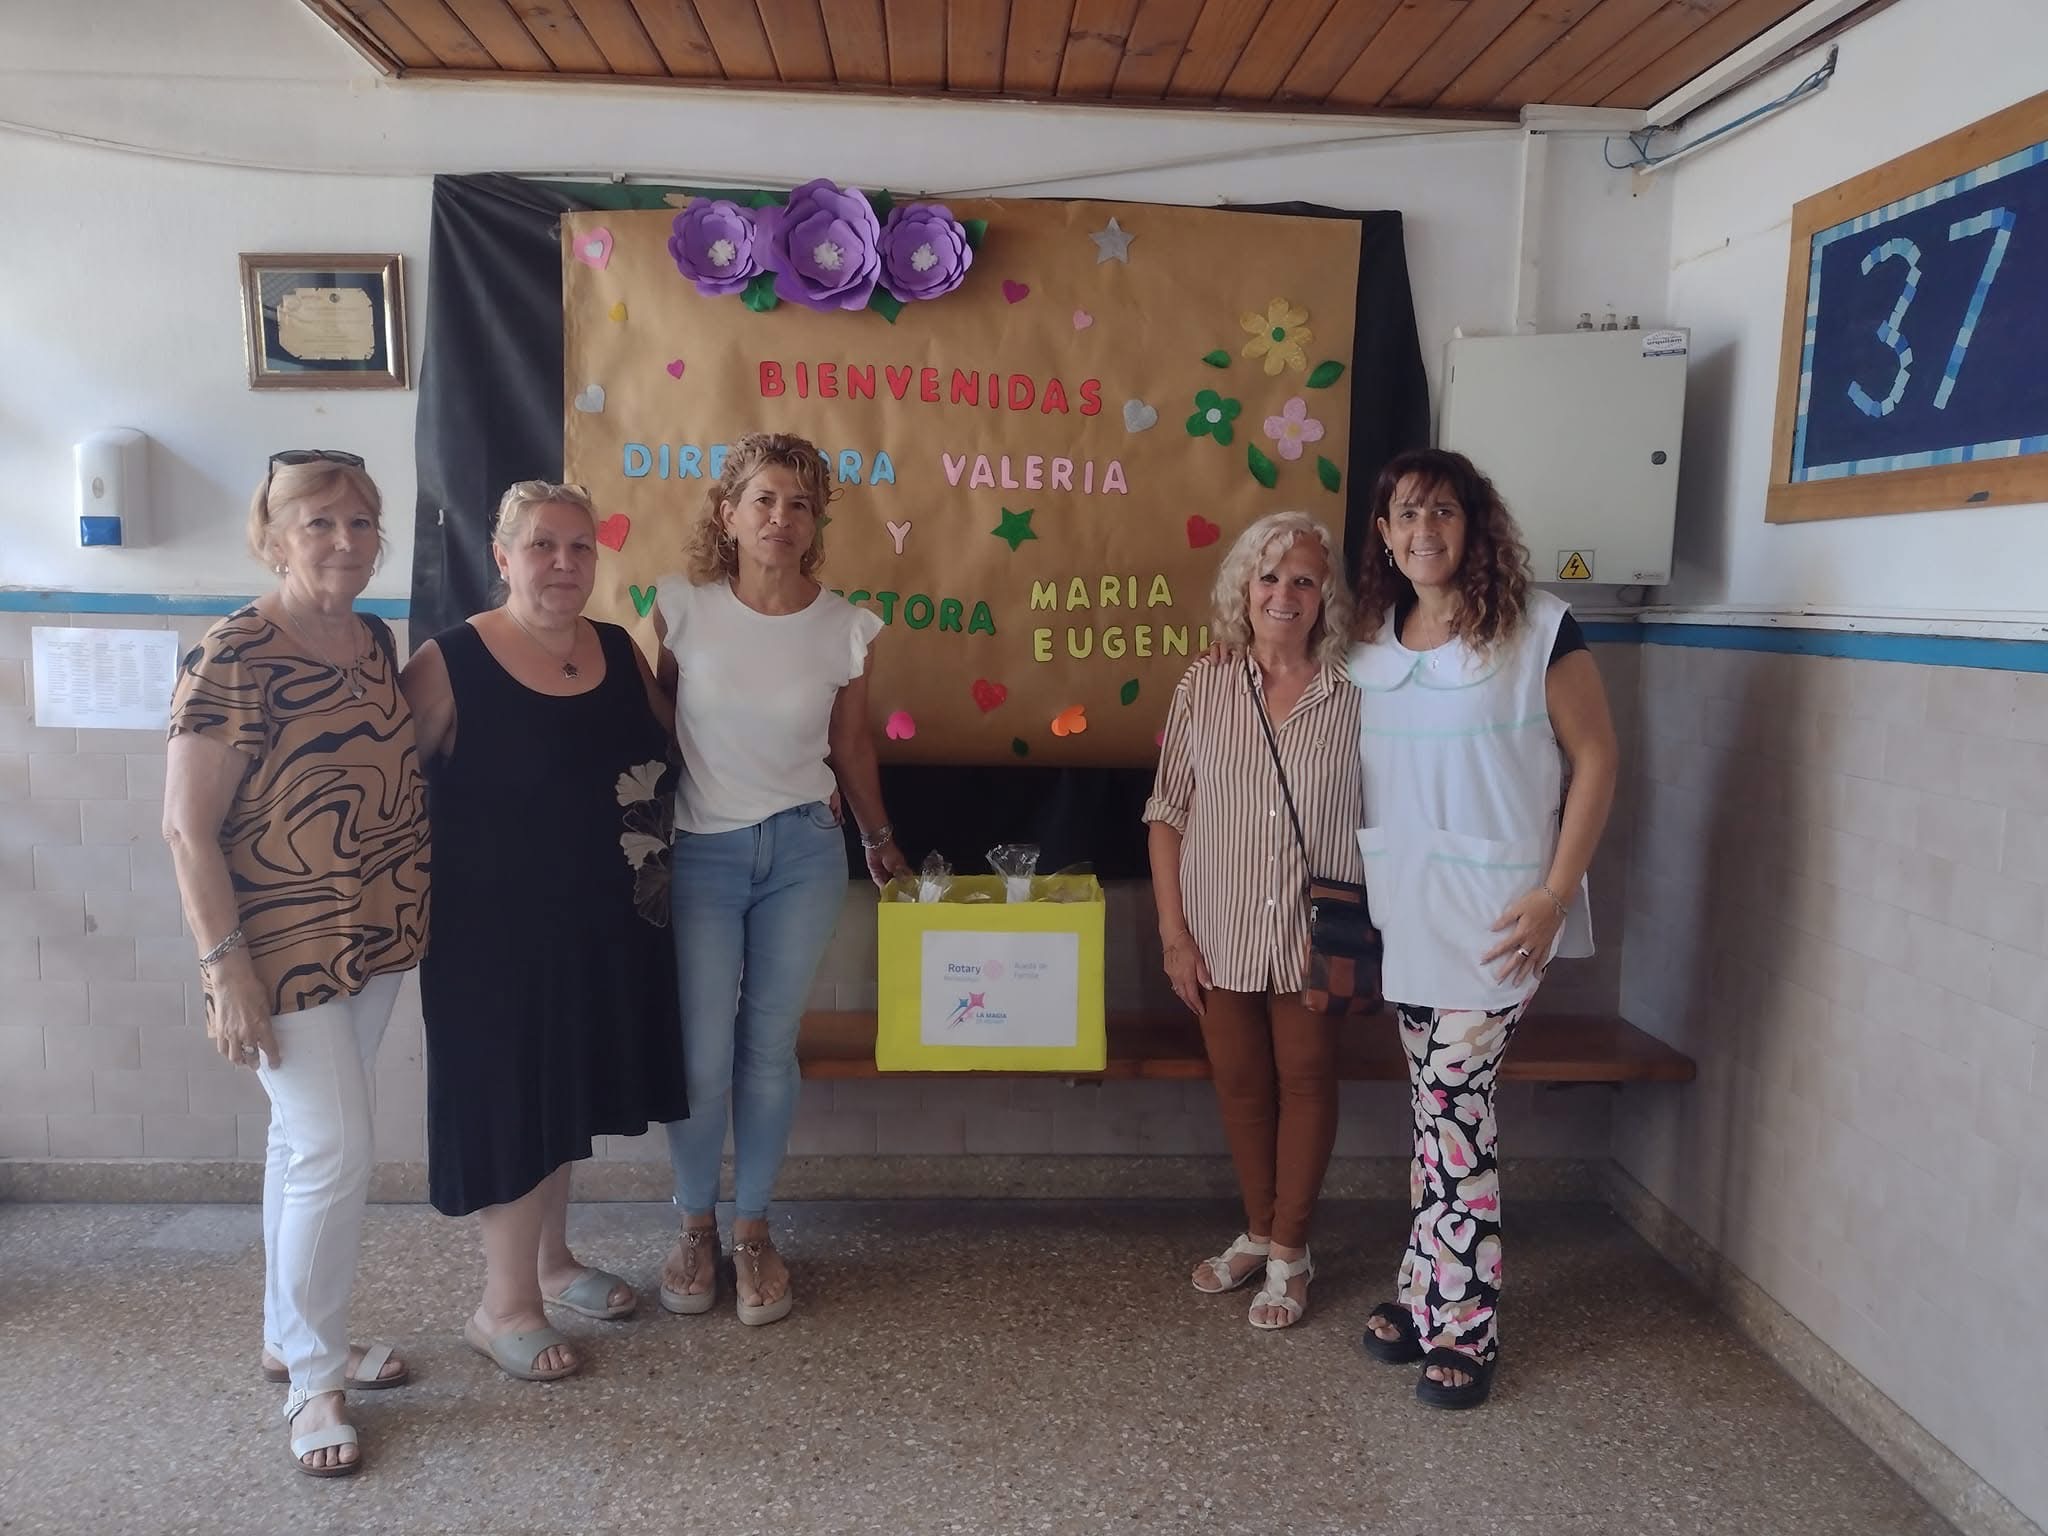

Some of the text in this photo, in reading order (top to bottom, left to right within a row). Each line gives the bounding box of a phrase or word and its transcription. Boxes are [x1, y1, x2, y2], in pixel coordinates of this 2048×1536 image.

[1848, 206, 2016, 418] 37
[759, 361, 1103, 416] BIENVENIDAS
[941, 452, 1128, 495] VALERIA
[886, 520, 912, 555] Y
[1030, 573, 1173, 612] MARIA
[1033, 624, 1209, 662] EUGENI
[948, 963, 981, 975] Rotary
